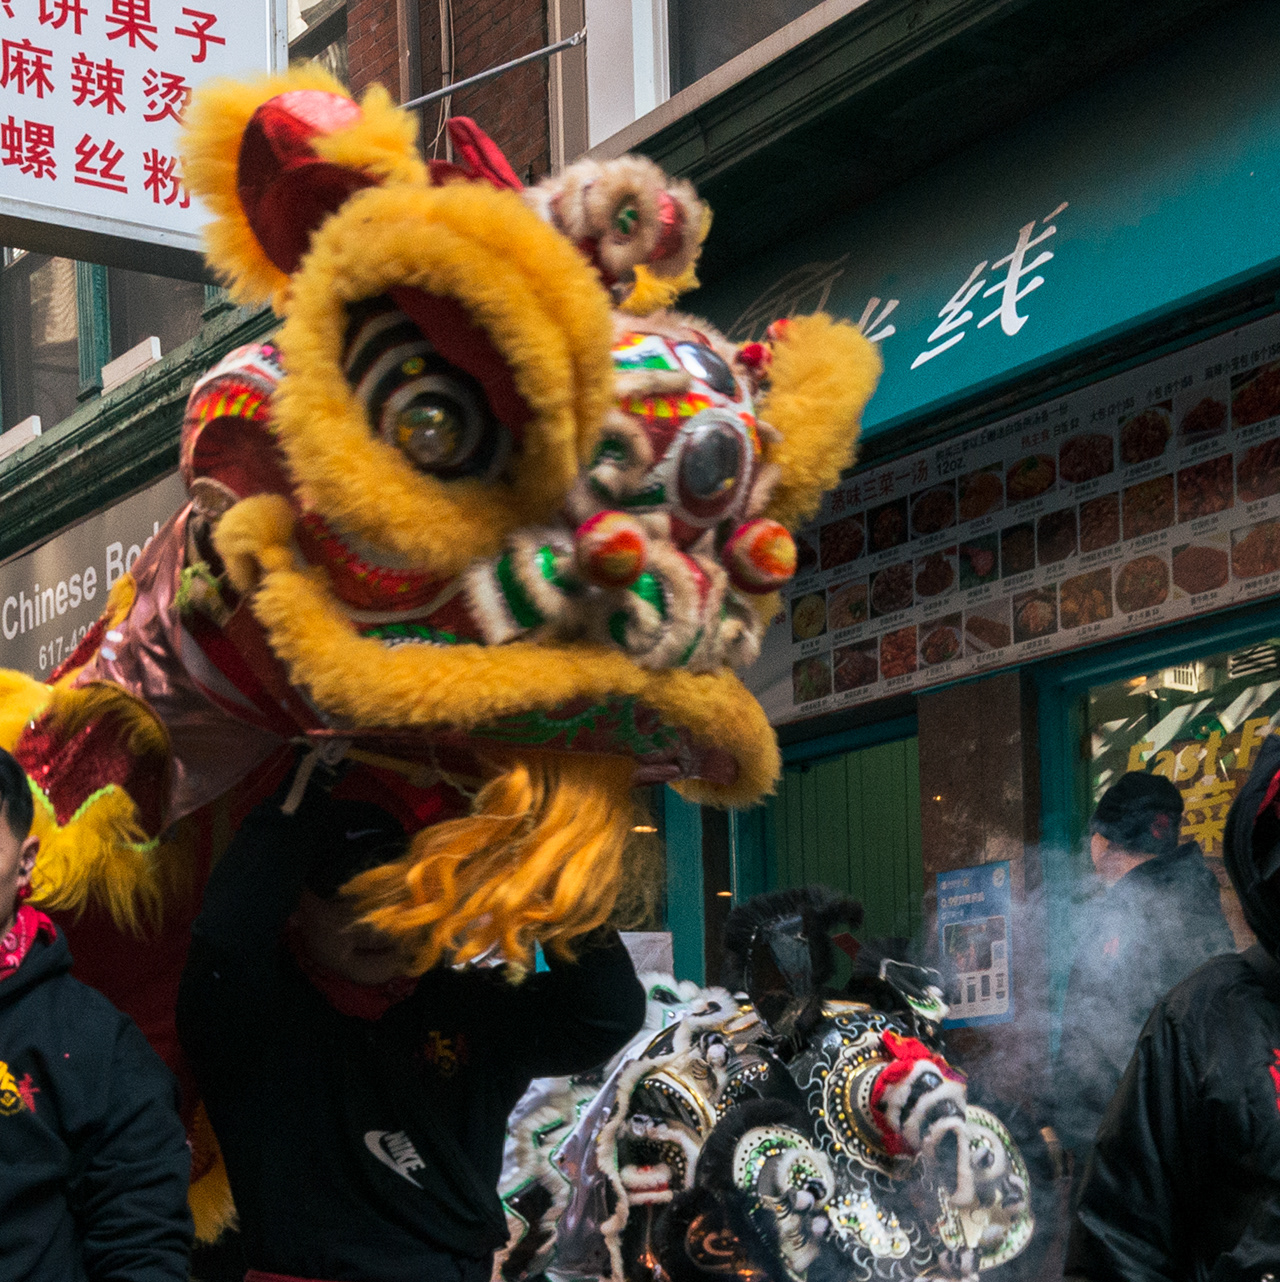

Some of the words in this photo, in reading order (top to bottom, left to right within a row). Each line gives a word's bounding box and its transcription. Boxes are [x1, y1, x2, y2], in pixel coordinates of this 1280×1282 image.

[0, 38, 193, 126] 麻辣烫
[0, 115, 192, 209] 螺丝粉
[1, 565, 98, 641] Chinese
[383, 1129, 427, 1170] NIKE
